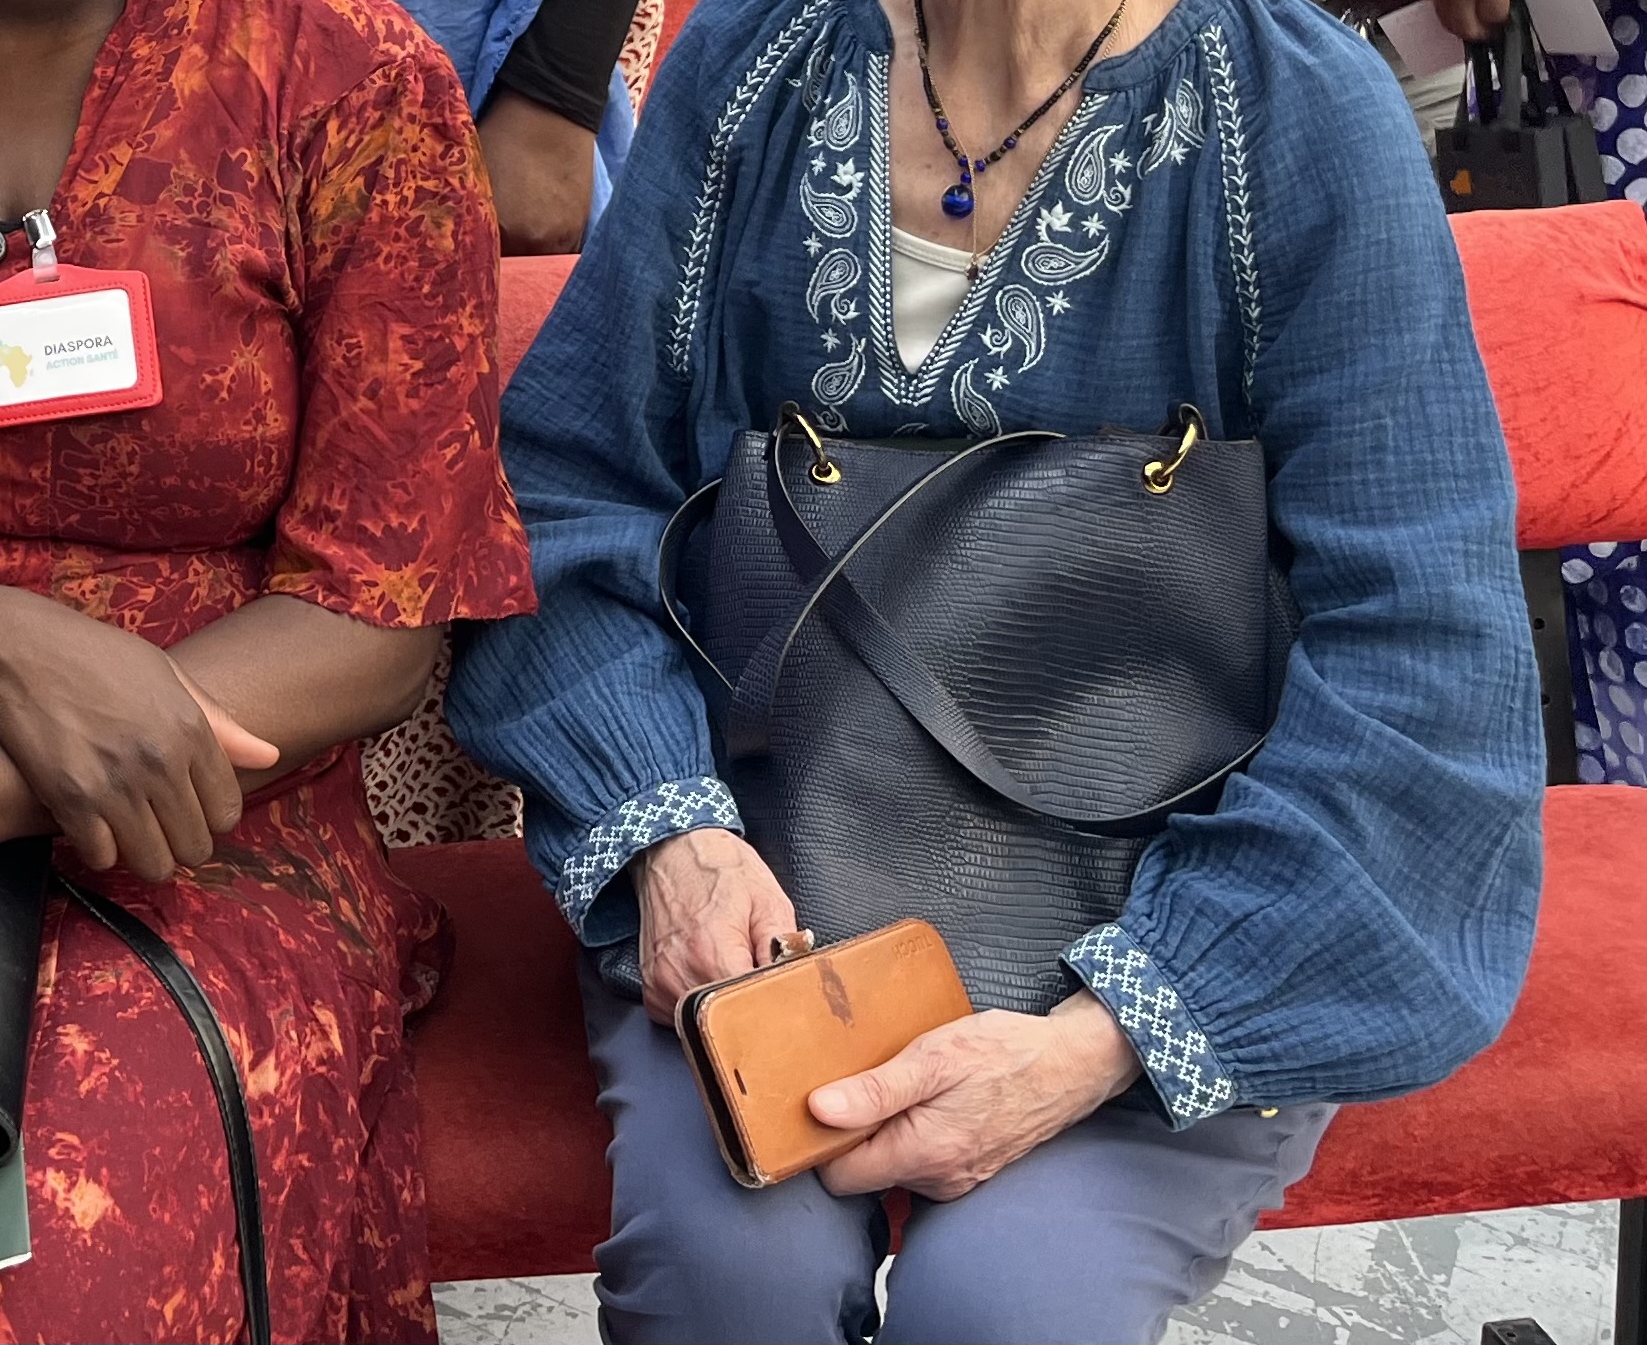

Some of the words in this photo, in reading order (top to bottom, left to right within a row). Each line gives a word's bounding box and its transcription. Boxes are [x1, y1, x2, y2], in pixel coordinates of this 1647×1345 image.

[44, 335, 113, 356] DIASPORA
[46, 356, 85, 370] ACTION
[86, 348, 119, 363] SANTÉ
